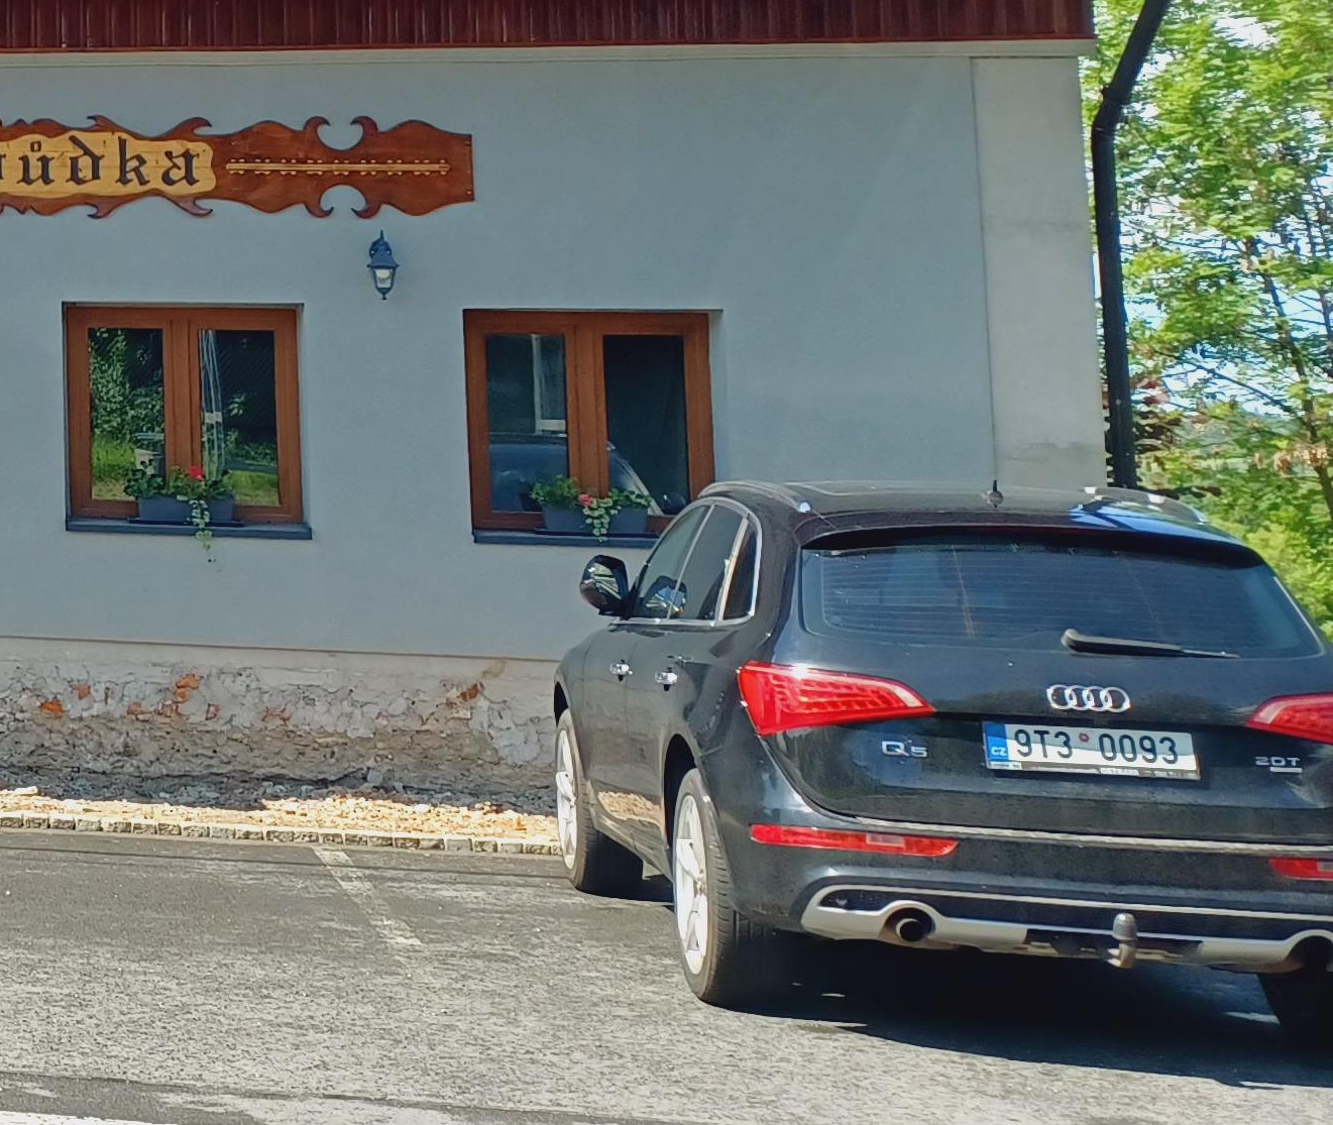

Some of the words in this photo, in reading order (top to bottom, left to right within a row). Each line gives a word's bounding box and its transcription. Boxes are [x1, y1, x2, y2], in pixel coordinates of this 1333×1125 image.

[882, 741, 928, 757] Q5
[1014, 729, 1073, 758] 9T3
[1098, 733, 1178, 764] 0093
